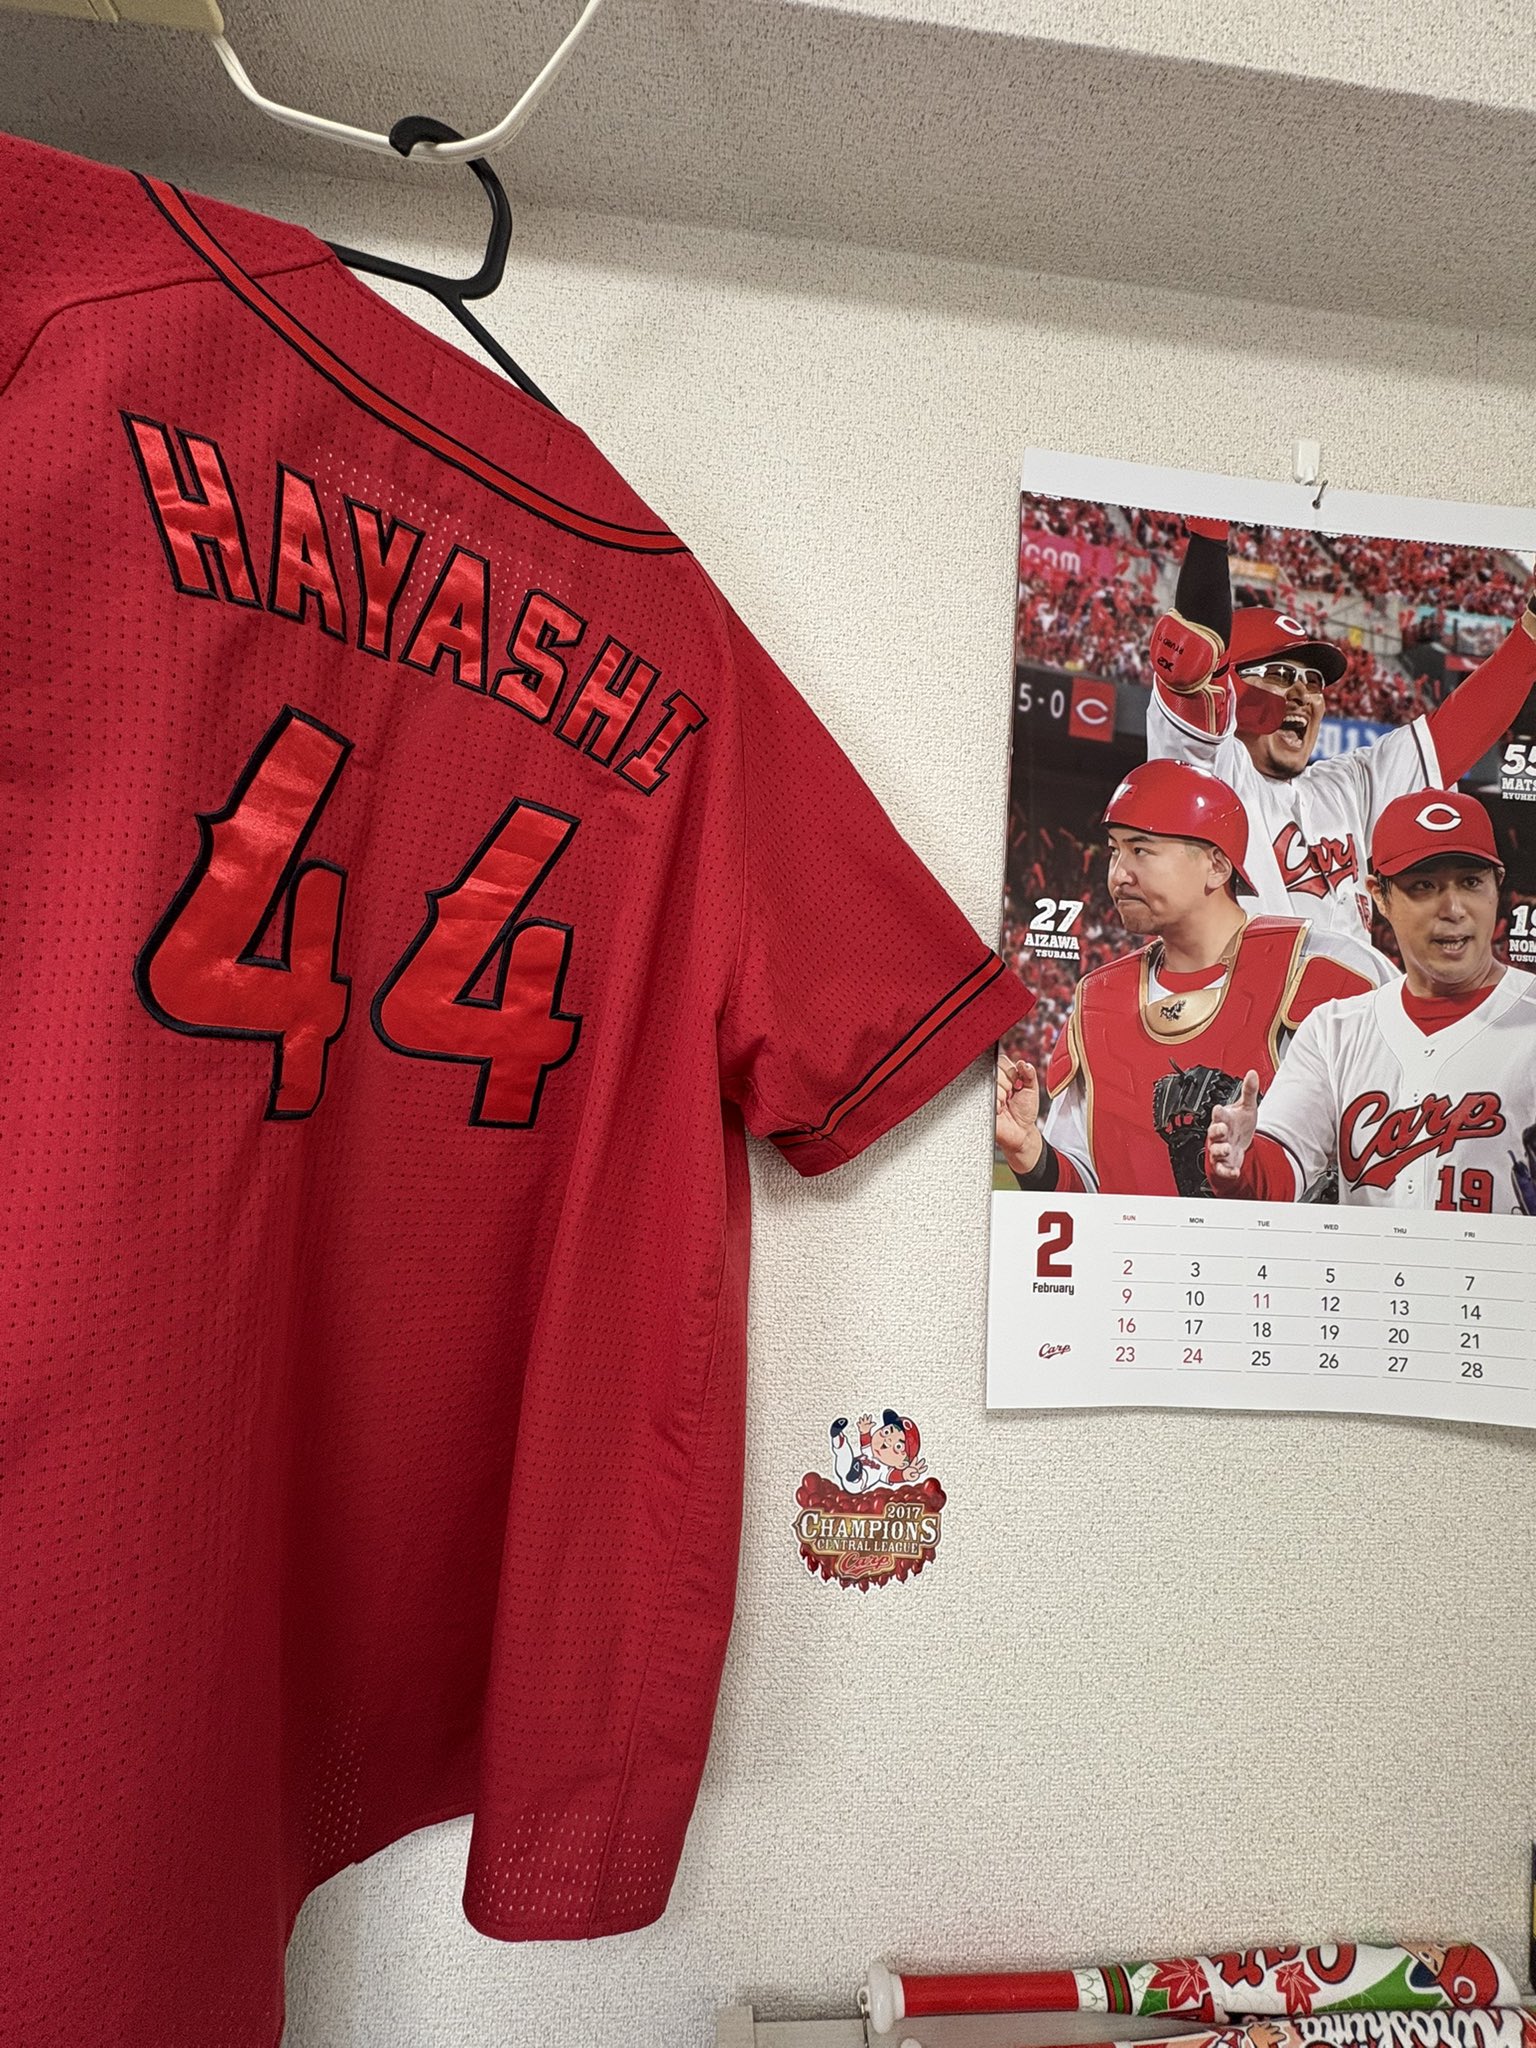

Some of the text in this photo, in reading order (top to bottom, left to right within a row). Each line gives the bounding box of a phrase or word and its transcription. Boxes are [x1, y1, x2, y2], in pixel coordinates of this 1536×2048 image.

[121, 410, 708, 796] HAYASHI
[133, 704, 583, 1128] 44
[1029, 897, 1084, 932] 27
[1509, 904, 1536, 937] 1
[1023, 932, 1080, 950] AIZAWA
[1035, 949, 1080, 960] TSUBASA
[1339, 1090, 1506, 1192] Carp
[1435, 1165, 1494, 1213] 19
[1037, 1211, 1073, 1277] 2
[1323, 1223, 1339, 1231] WED
[1393, 1227, 1408, 1235] THU
[1033, 1282, 1074, 1295] February
[1123, 1260, 1475, 1290] 2 3 4 5 6 7
[1122, 1289, 1481, 1320] 9 10 11 12 13 14
[1118, 1318, 1479, 1349] 16 17 18 19 20 21
[1039, 1343, 1071, 1359] Carp
[1116, 1346, 1483, 1378] 23 24 25 26 27 28
[887, 1504, 923, 1519] 2017
[800, 1512, 937, 1544] CHAMPIONS
[817, 1538, 918, 1554] CENTRAL LEAGUE
[841, 1551, 891, 1576] Carp
